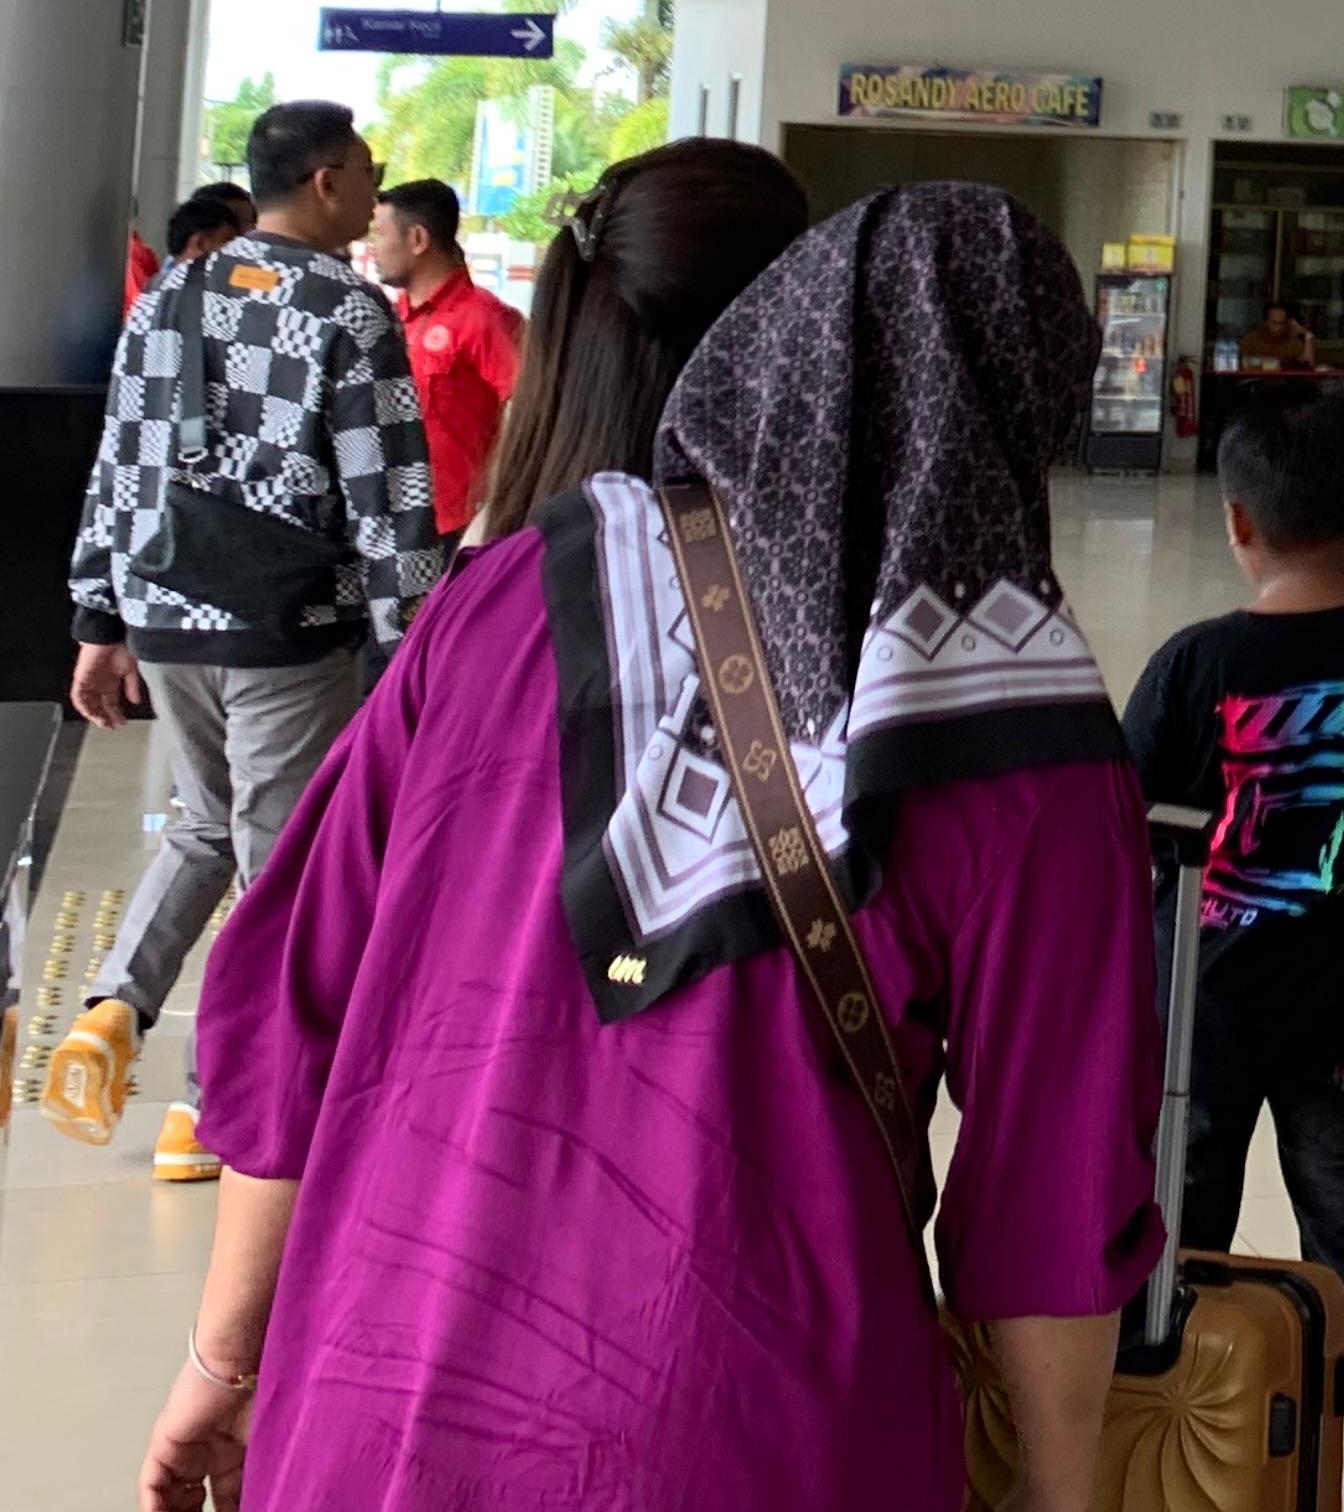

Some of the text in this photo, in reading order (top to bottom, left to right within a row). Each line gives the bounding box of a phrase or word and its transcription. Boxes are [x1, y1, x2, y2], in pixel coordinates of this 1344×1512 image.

[851, 72, 1089, 116] ROSANDY AERO CAFE
